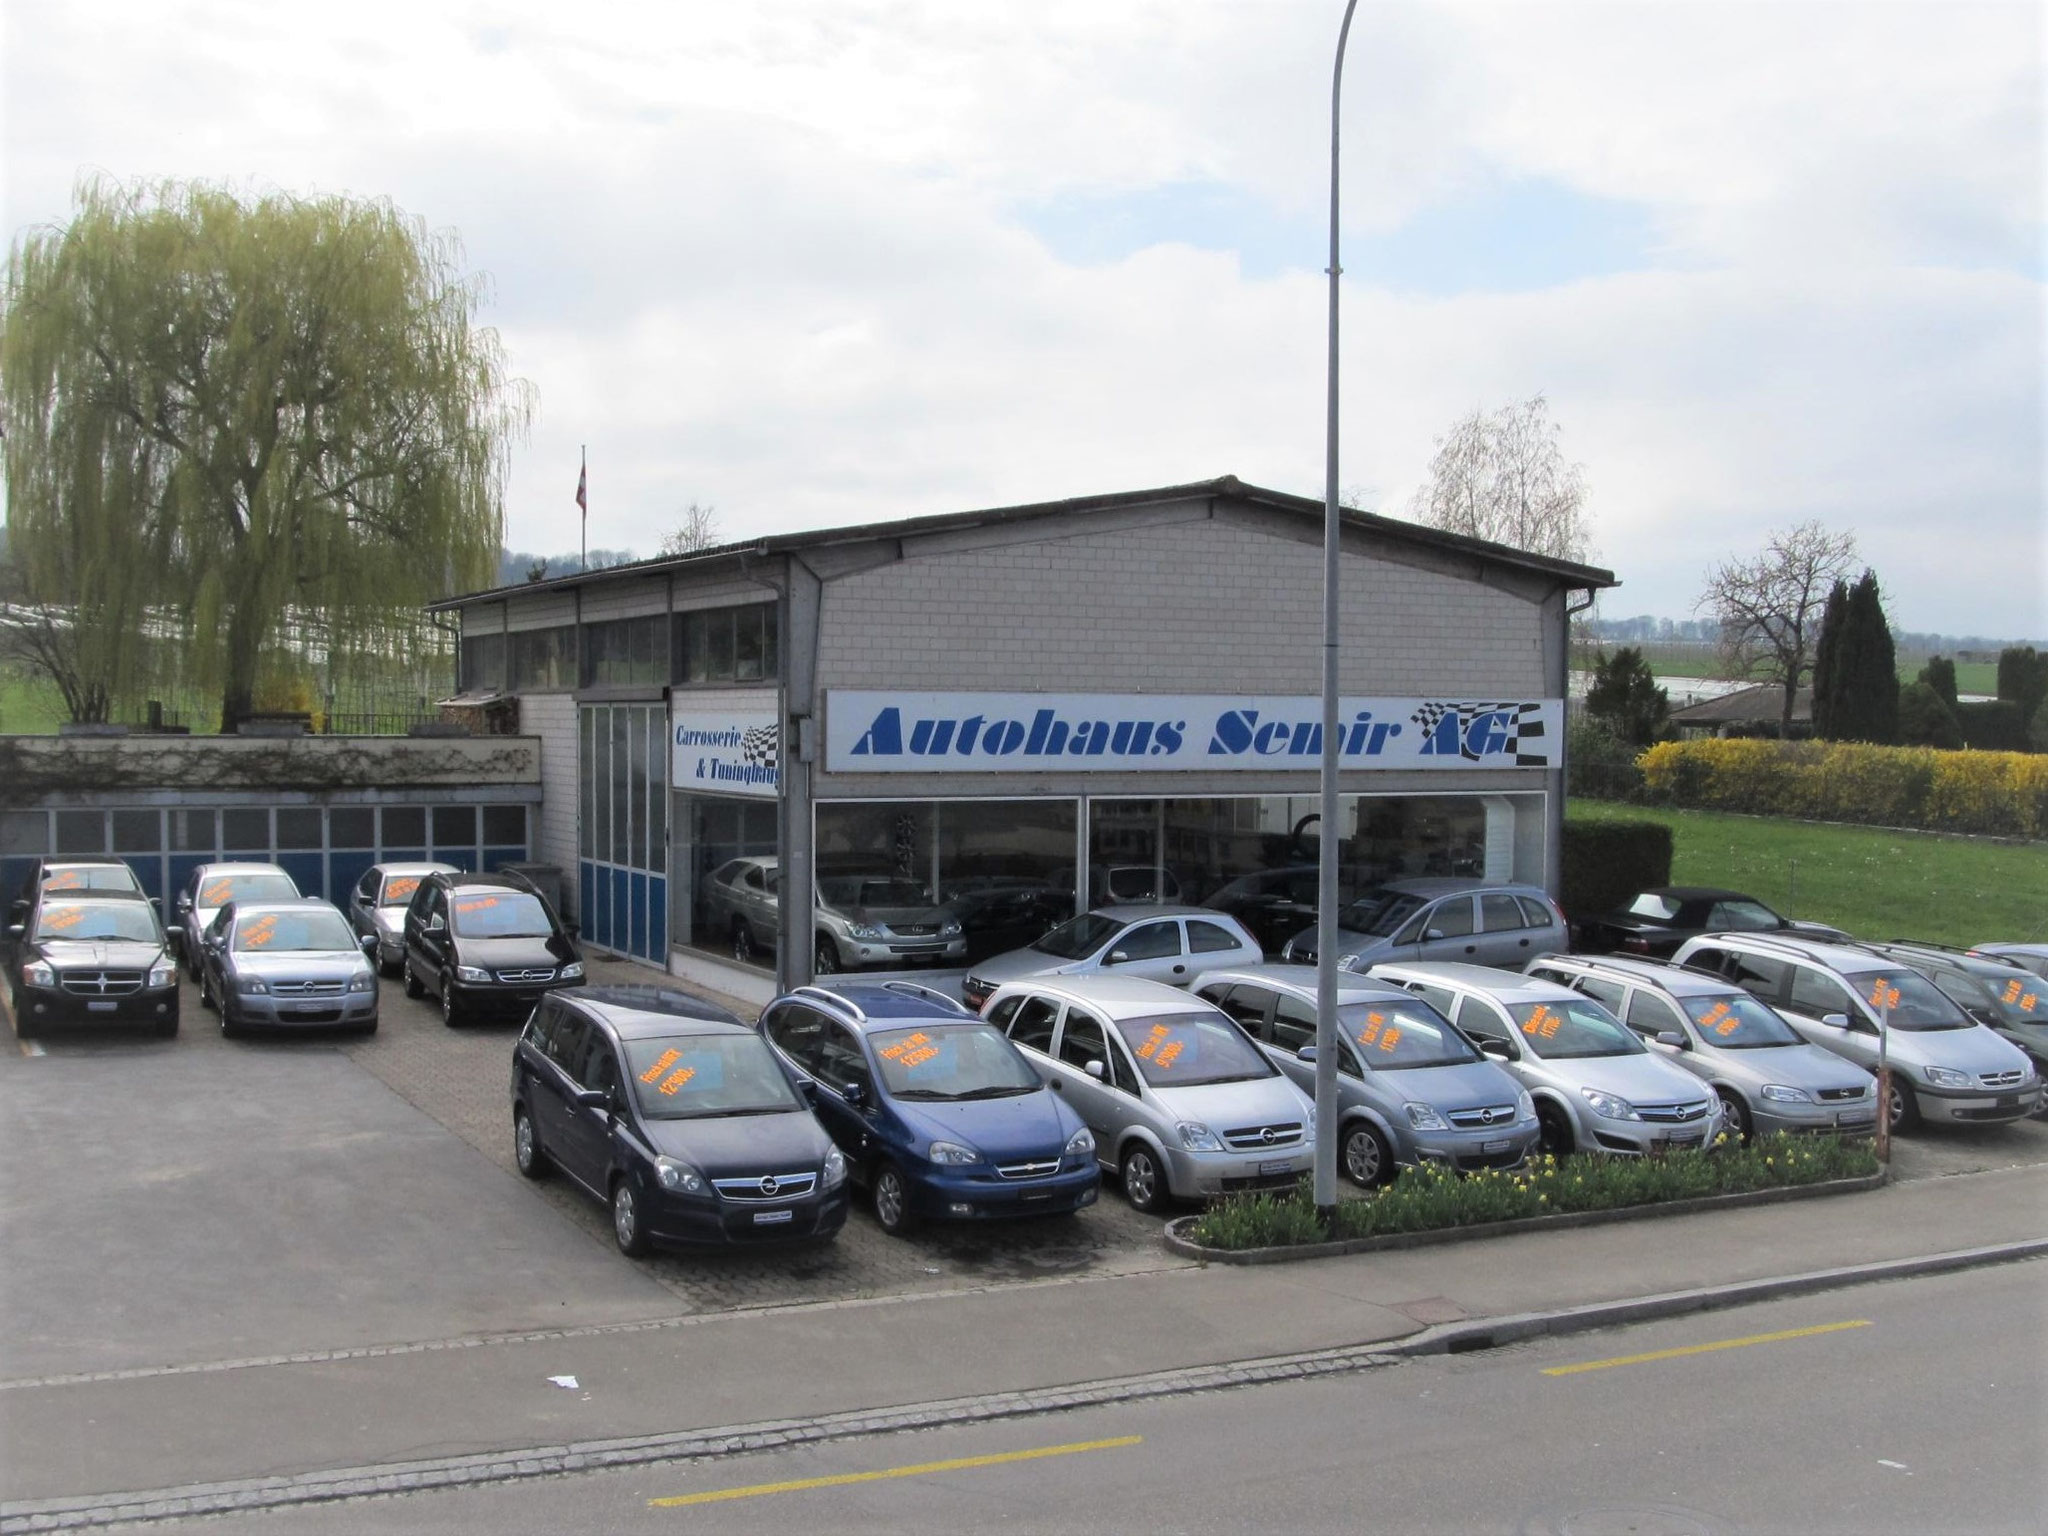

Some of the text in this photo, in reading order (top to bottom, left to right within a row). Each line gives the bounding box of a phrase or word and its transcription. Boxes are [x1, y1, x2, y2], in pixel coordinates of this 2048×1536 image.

[676, 725, 742, 748] Carrosserie
[850, 707, 1512, 756] Autohaus Semir AG
[696, 758, 706, 779] &
